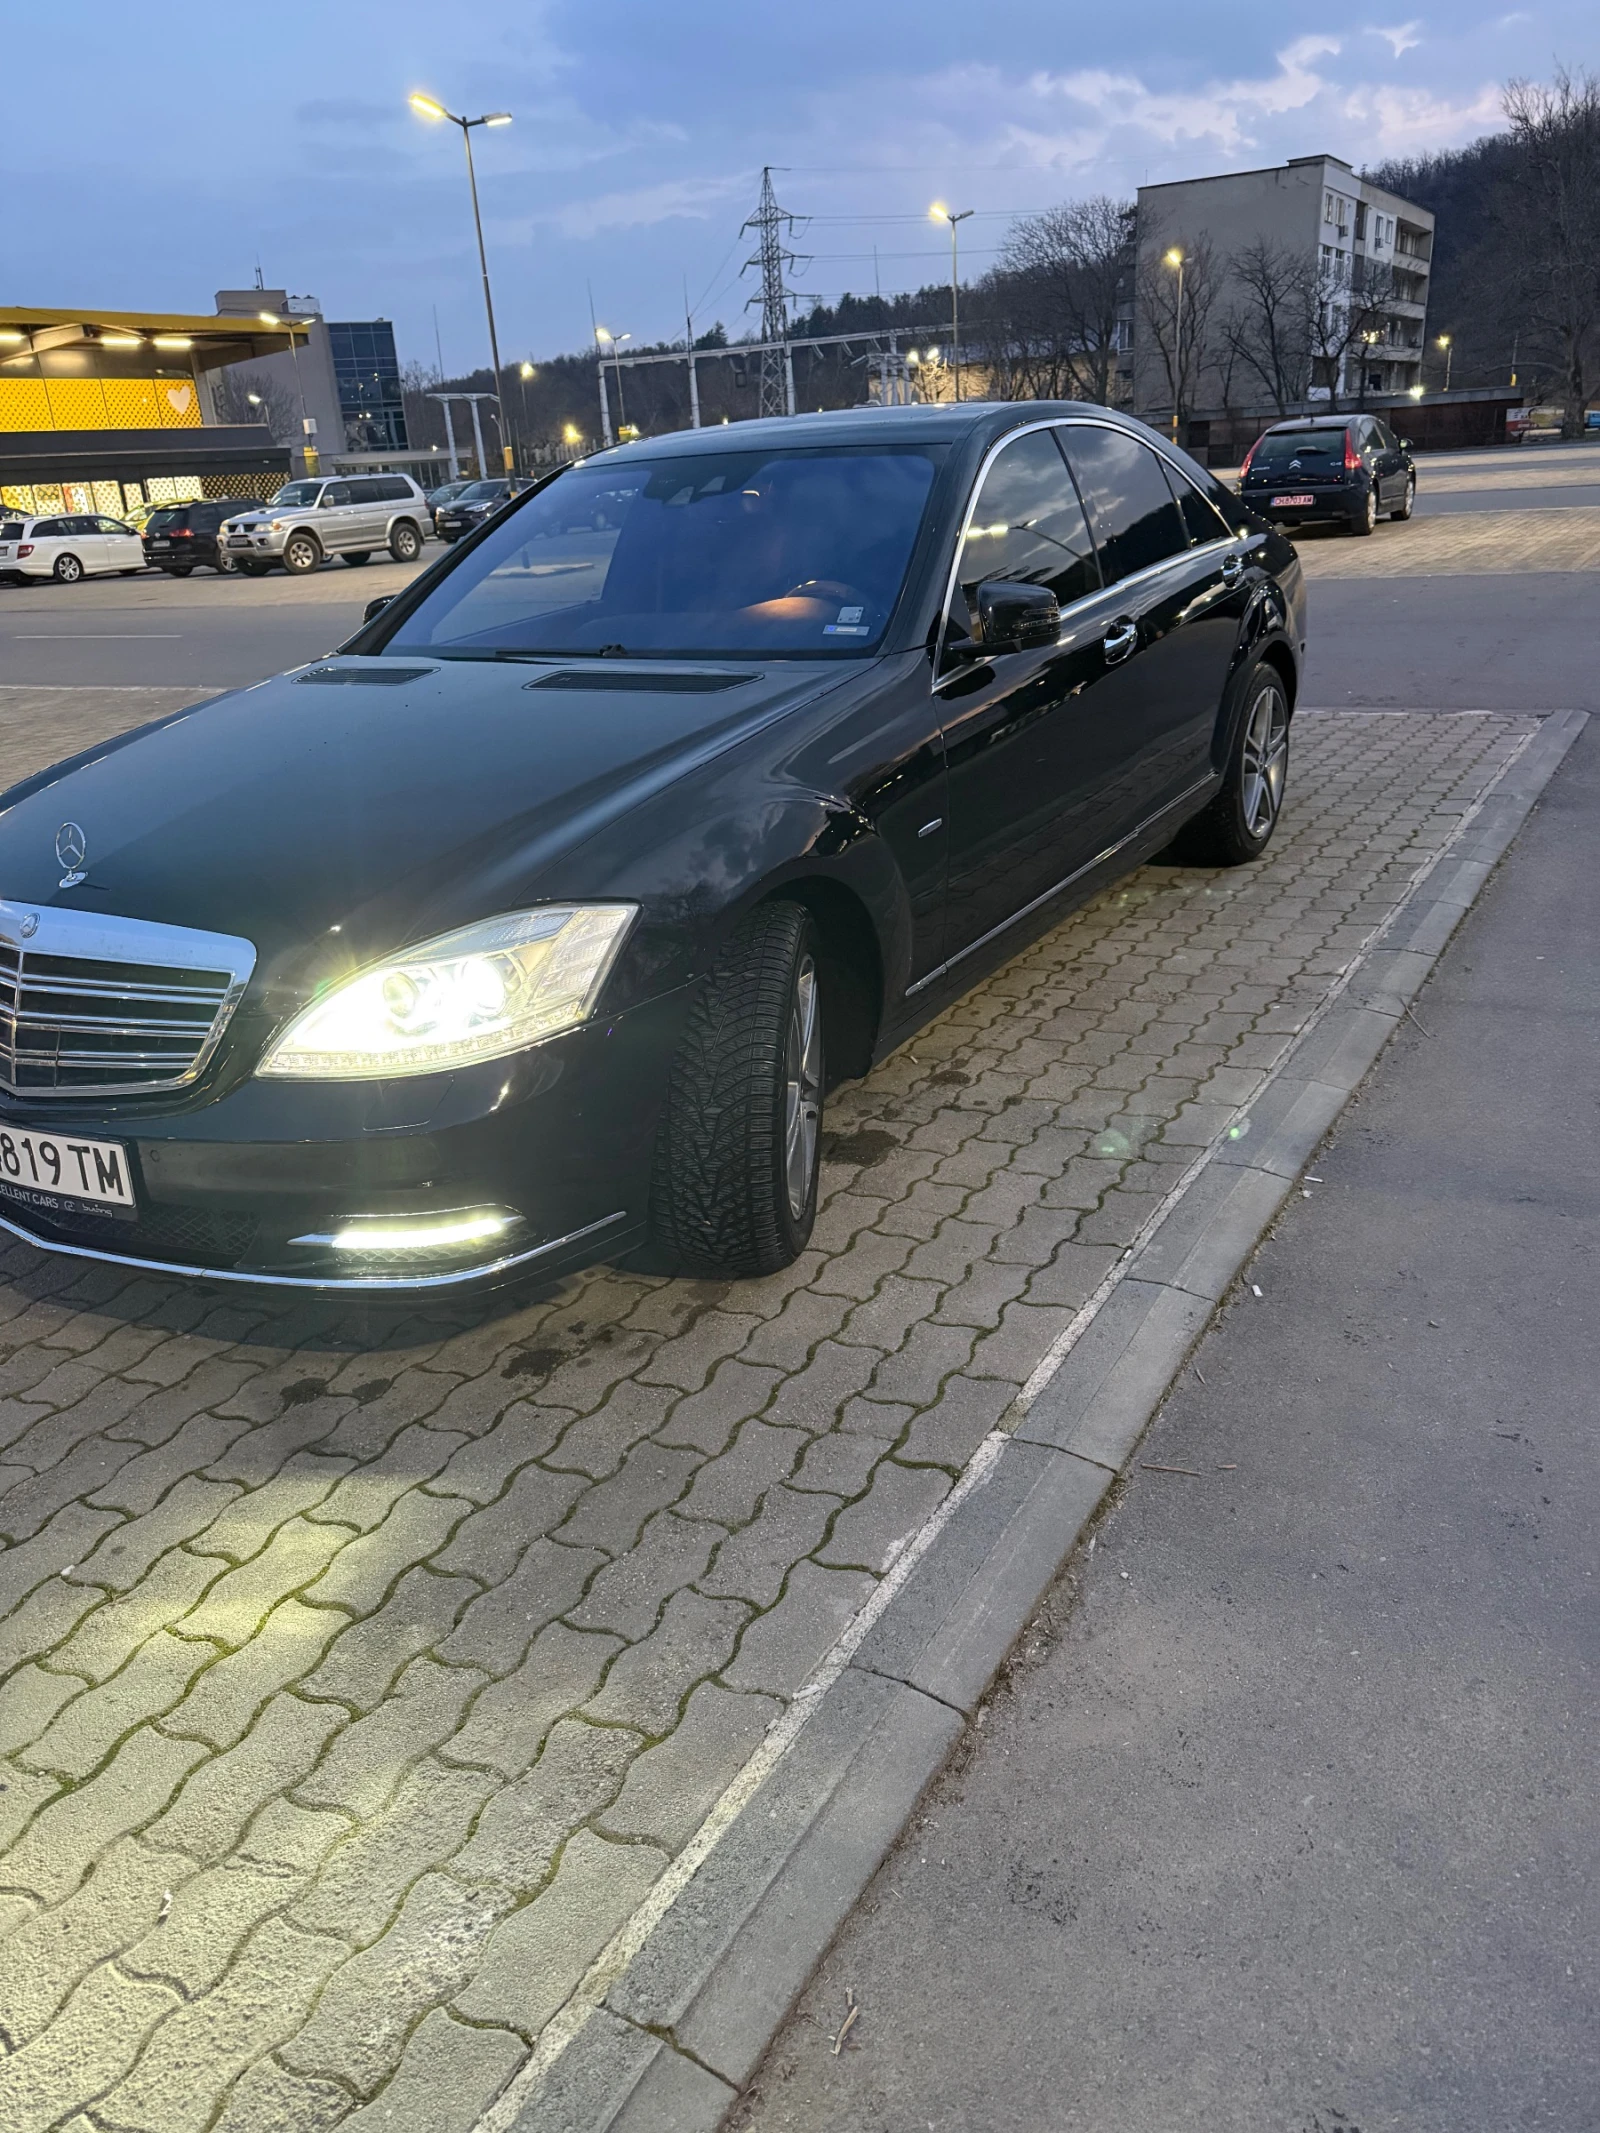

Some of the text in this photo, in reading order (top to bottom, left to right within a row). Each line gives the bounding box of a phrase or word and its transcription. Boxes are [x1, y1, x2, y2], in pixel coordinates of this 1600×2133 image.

[0, 1133, 124, 1197] 819 TM
[32, 1194, 59, 1209] CARS
